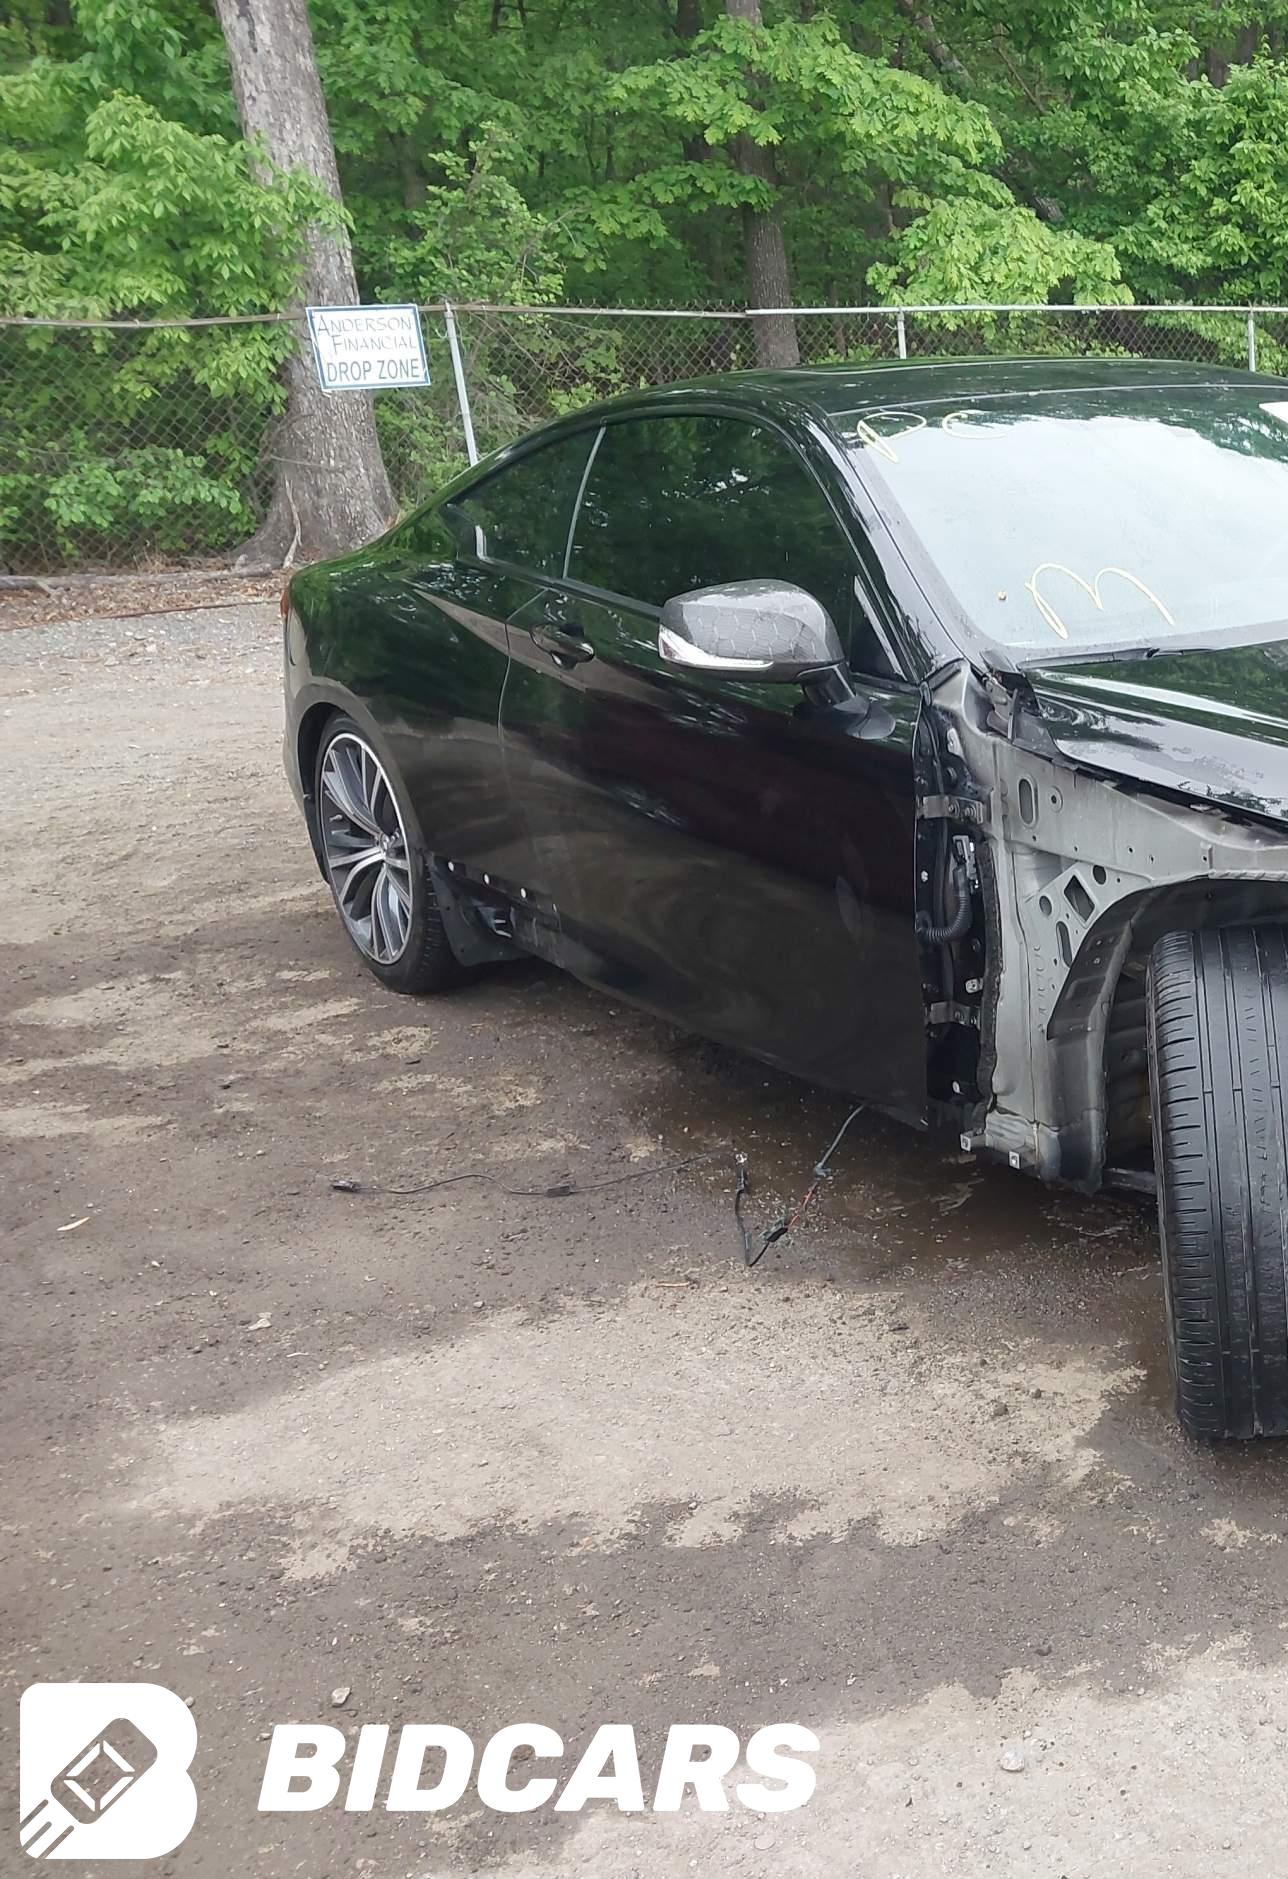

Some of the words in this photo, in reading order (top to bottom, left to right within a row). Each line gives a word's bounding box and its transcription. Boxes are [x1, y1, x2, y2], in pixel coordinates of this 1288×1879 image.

[318, 315, 412, 336] ANDERSON
[331, 334, 417, 354] FINANCIAL
[326, 360, 372, 382] DROP
[376, 358, 420, 379] ZONE
